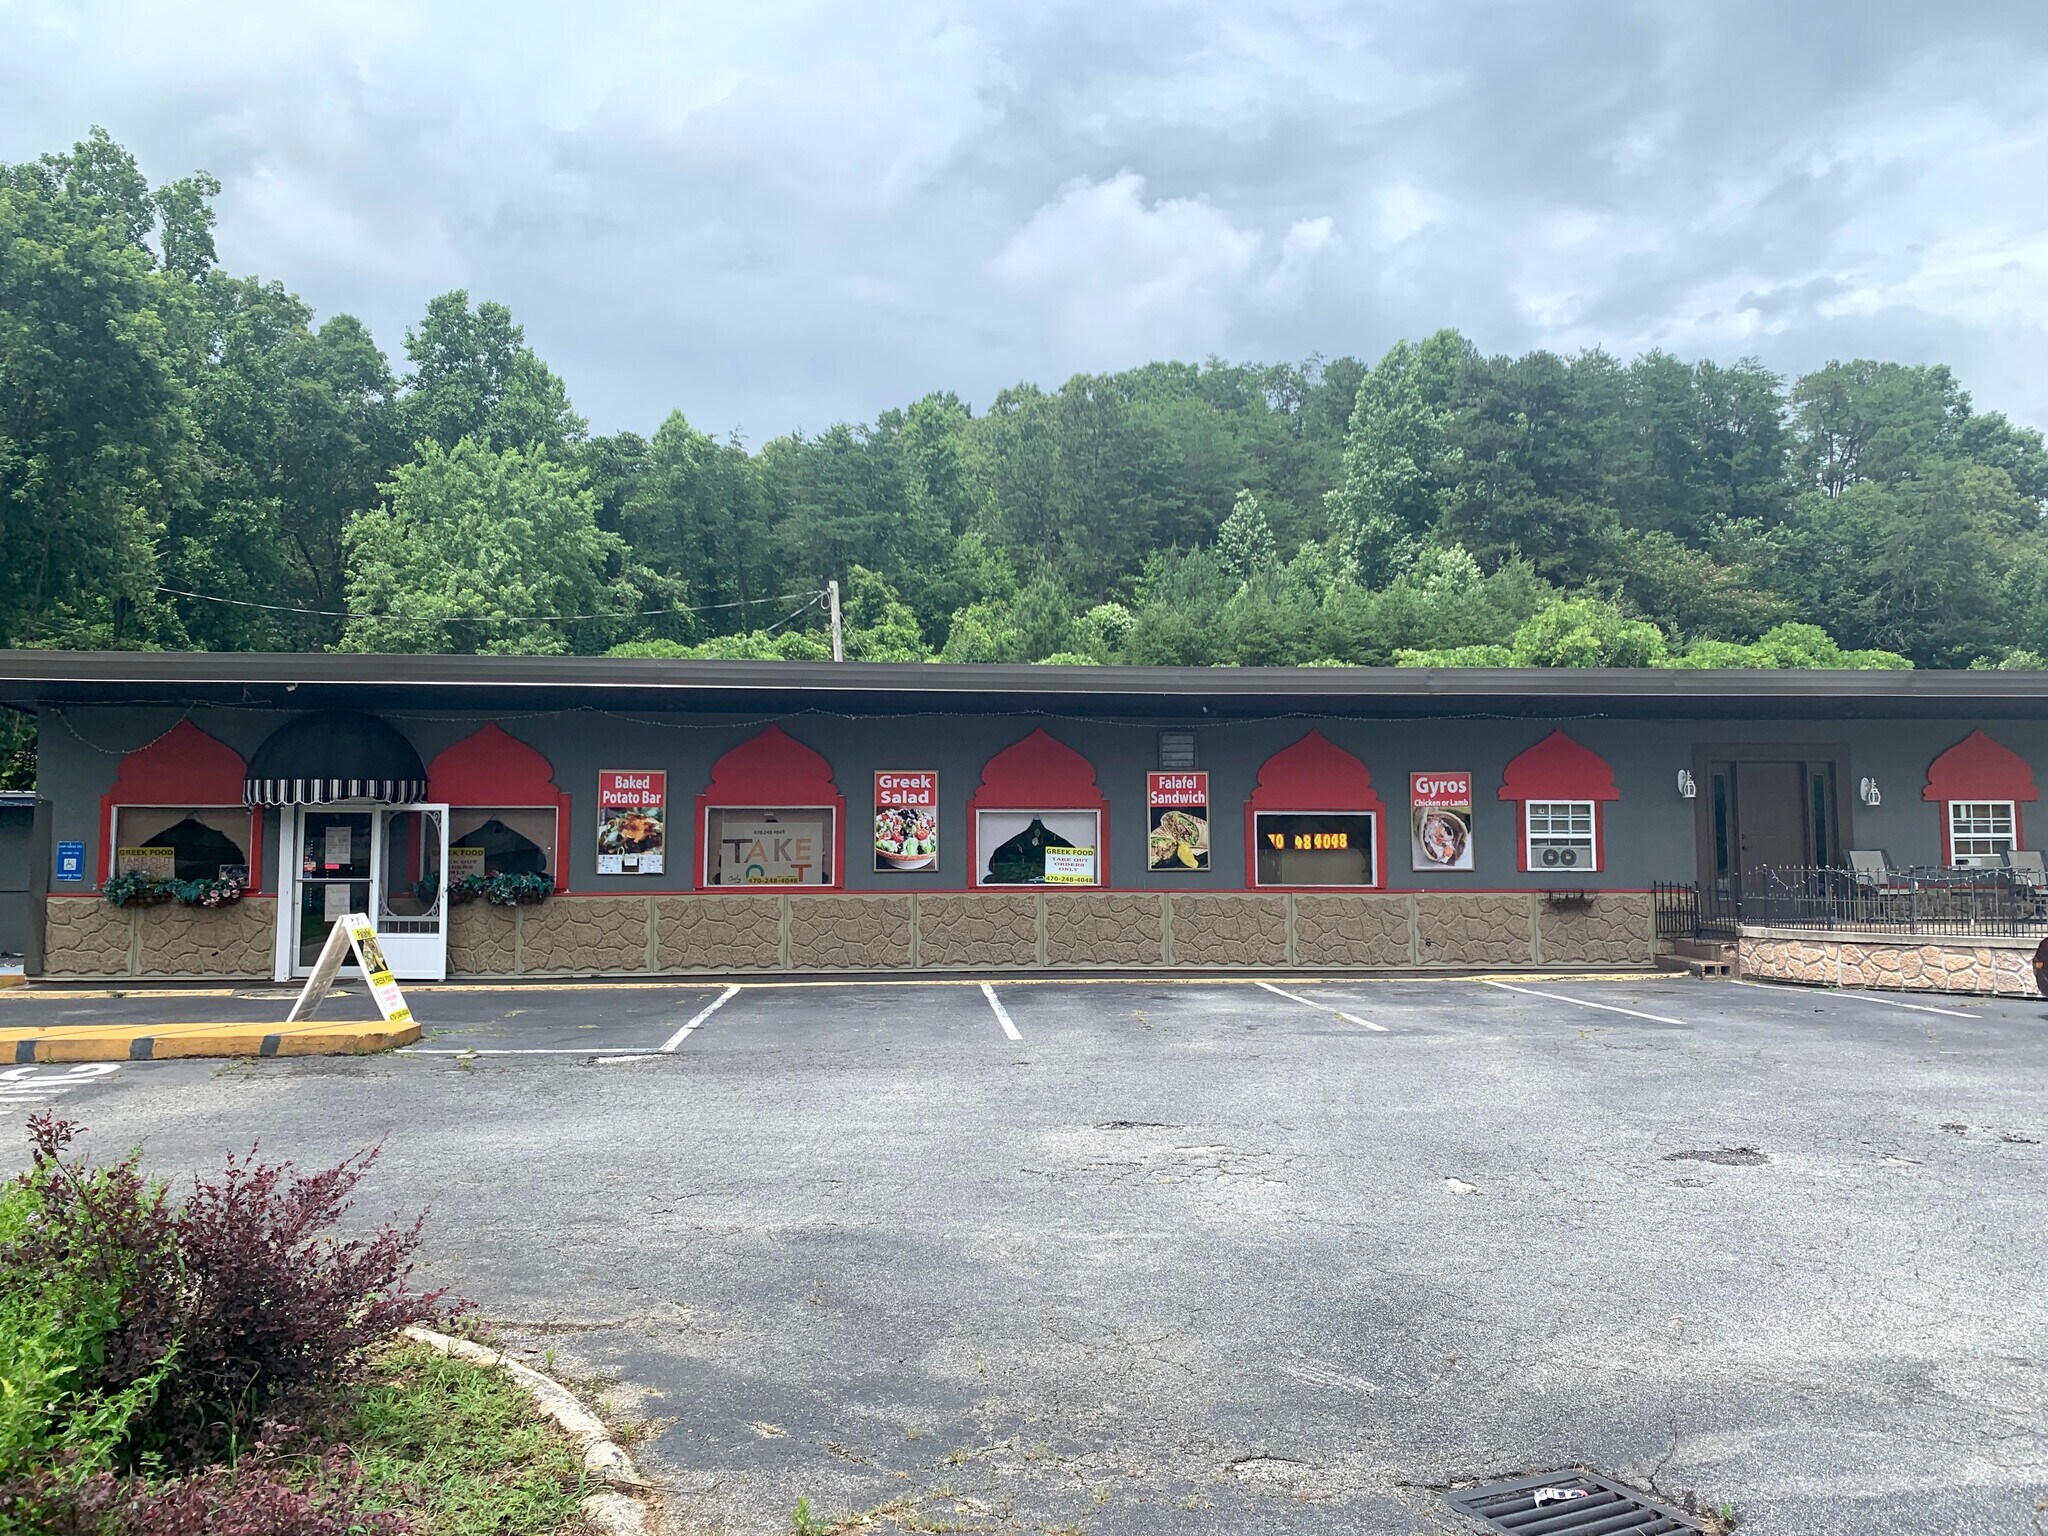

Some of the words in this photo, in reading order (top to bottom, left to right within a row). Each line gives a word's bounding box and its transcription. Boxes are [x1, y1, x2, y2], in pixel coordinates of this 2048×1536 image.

[615, 775, 650, 790] Baked
[879, 774, 932, 789] Greek
[1159, 775, 1197, 790] Falafel
[1416, 776, 1467, 798] Gyros
[603, 790, 640, 804] Potato
[642, 790, 662, 804] Bar
[881, 790, 929, 804] Salad
[1151, 790, 1206, 804] Sandwich
[1414, 799, 1440, 807] Chicken
[1450, 799, 1469, 807] Lamb
[723, 838, 812, 864] TAKE
[1046, 875, 1094, 884] 470-248-4048
